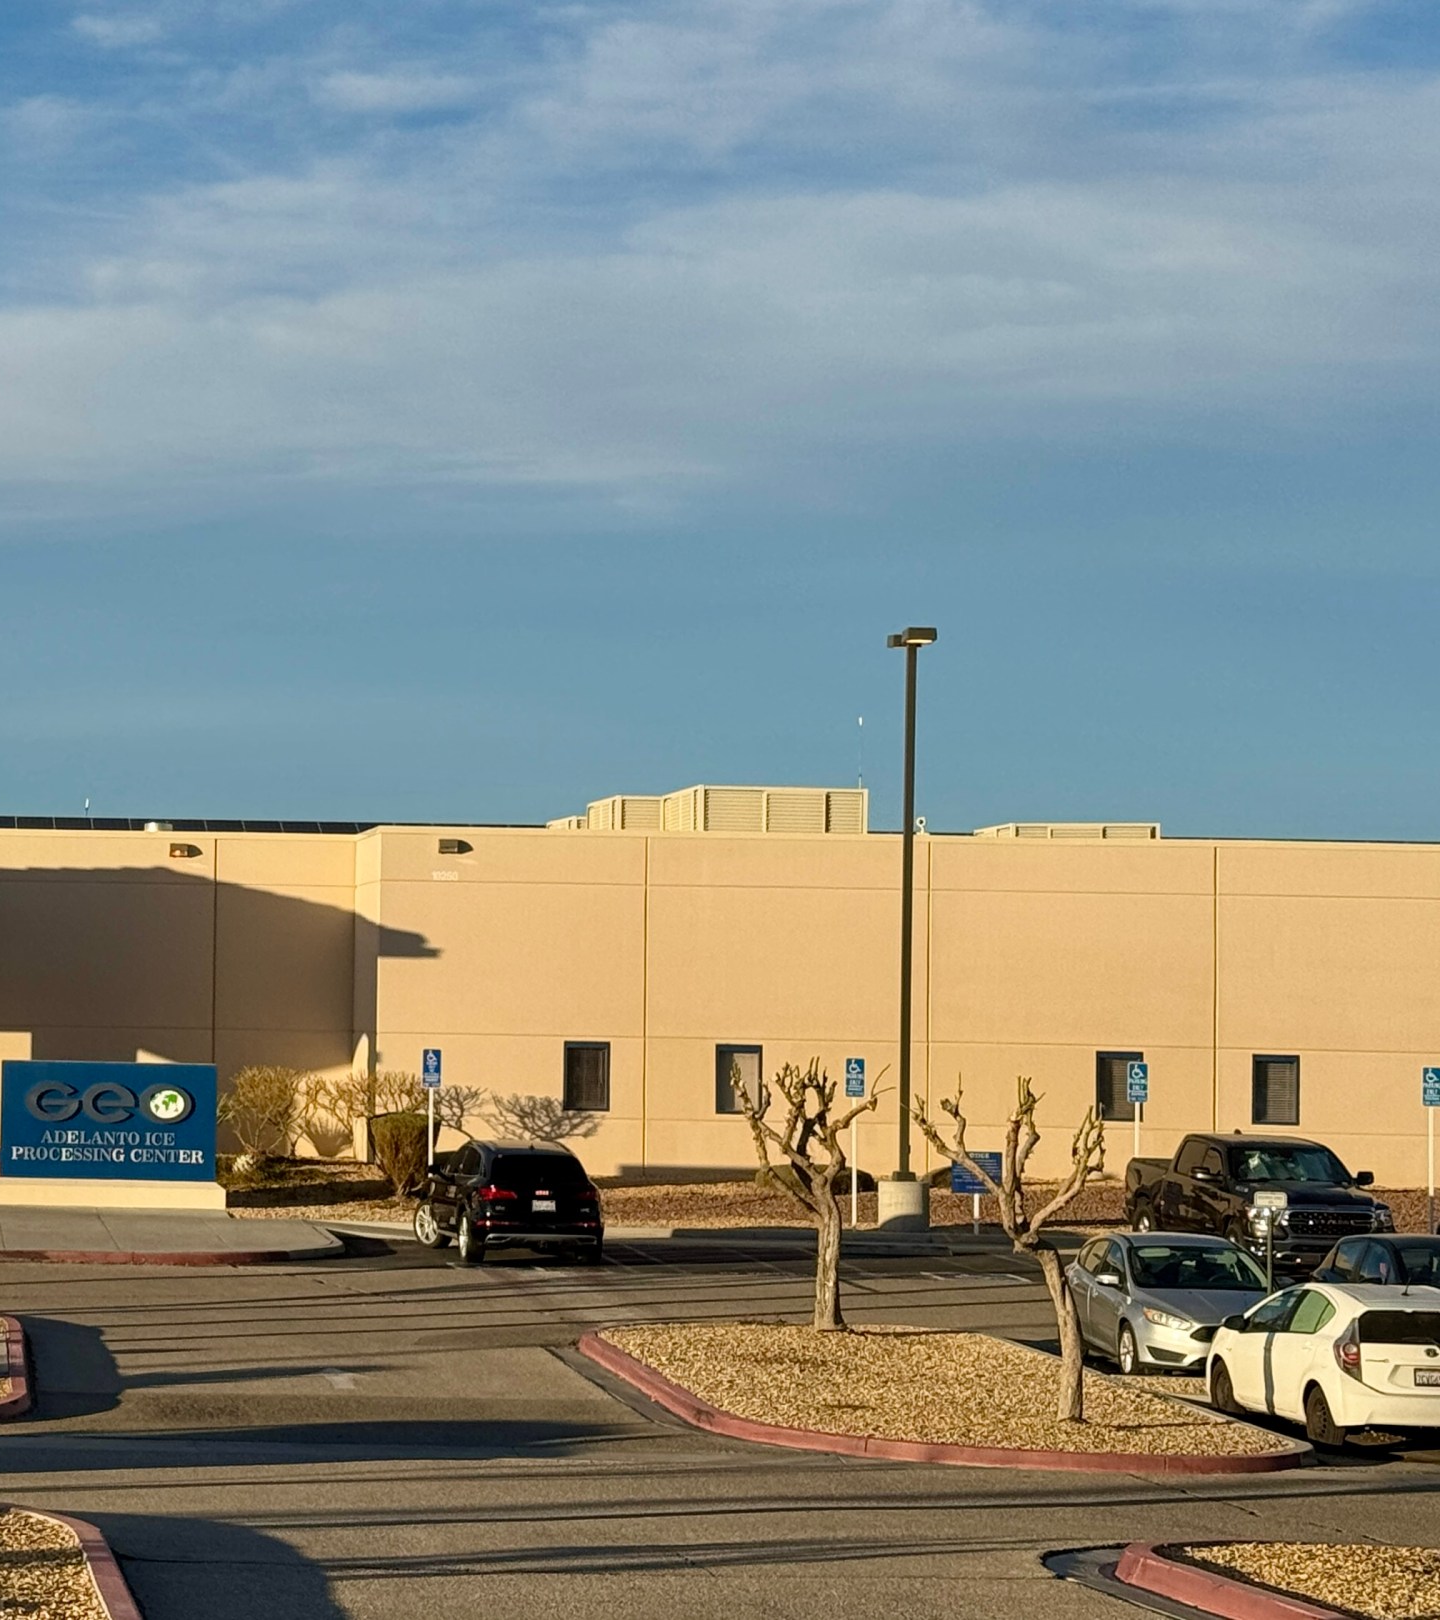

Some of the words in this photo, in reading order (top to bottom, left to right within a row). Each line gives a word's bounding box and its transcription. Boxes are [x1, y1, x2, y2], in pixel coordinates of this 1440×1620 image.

[40, 1129, 140, 1146] ADELANTO
[144, 1131, 176, 1146] ICE
[11, 1145, 125, 1163] PROCESSING
[129, 1148, 205, 1165] CENTER
